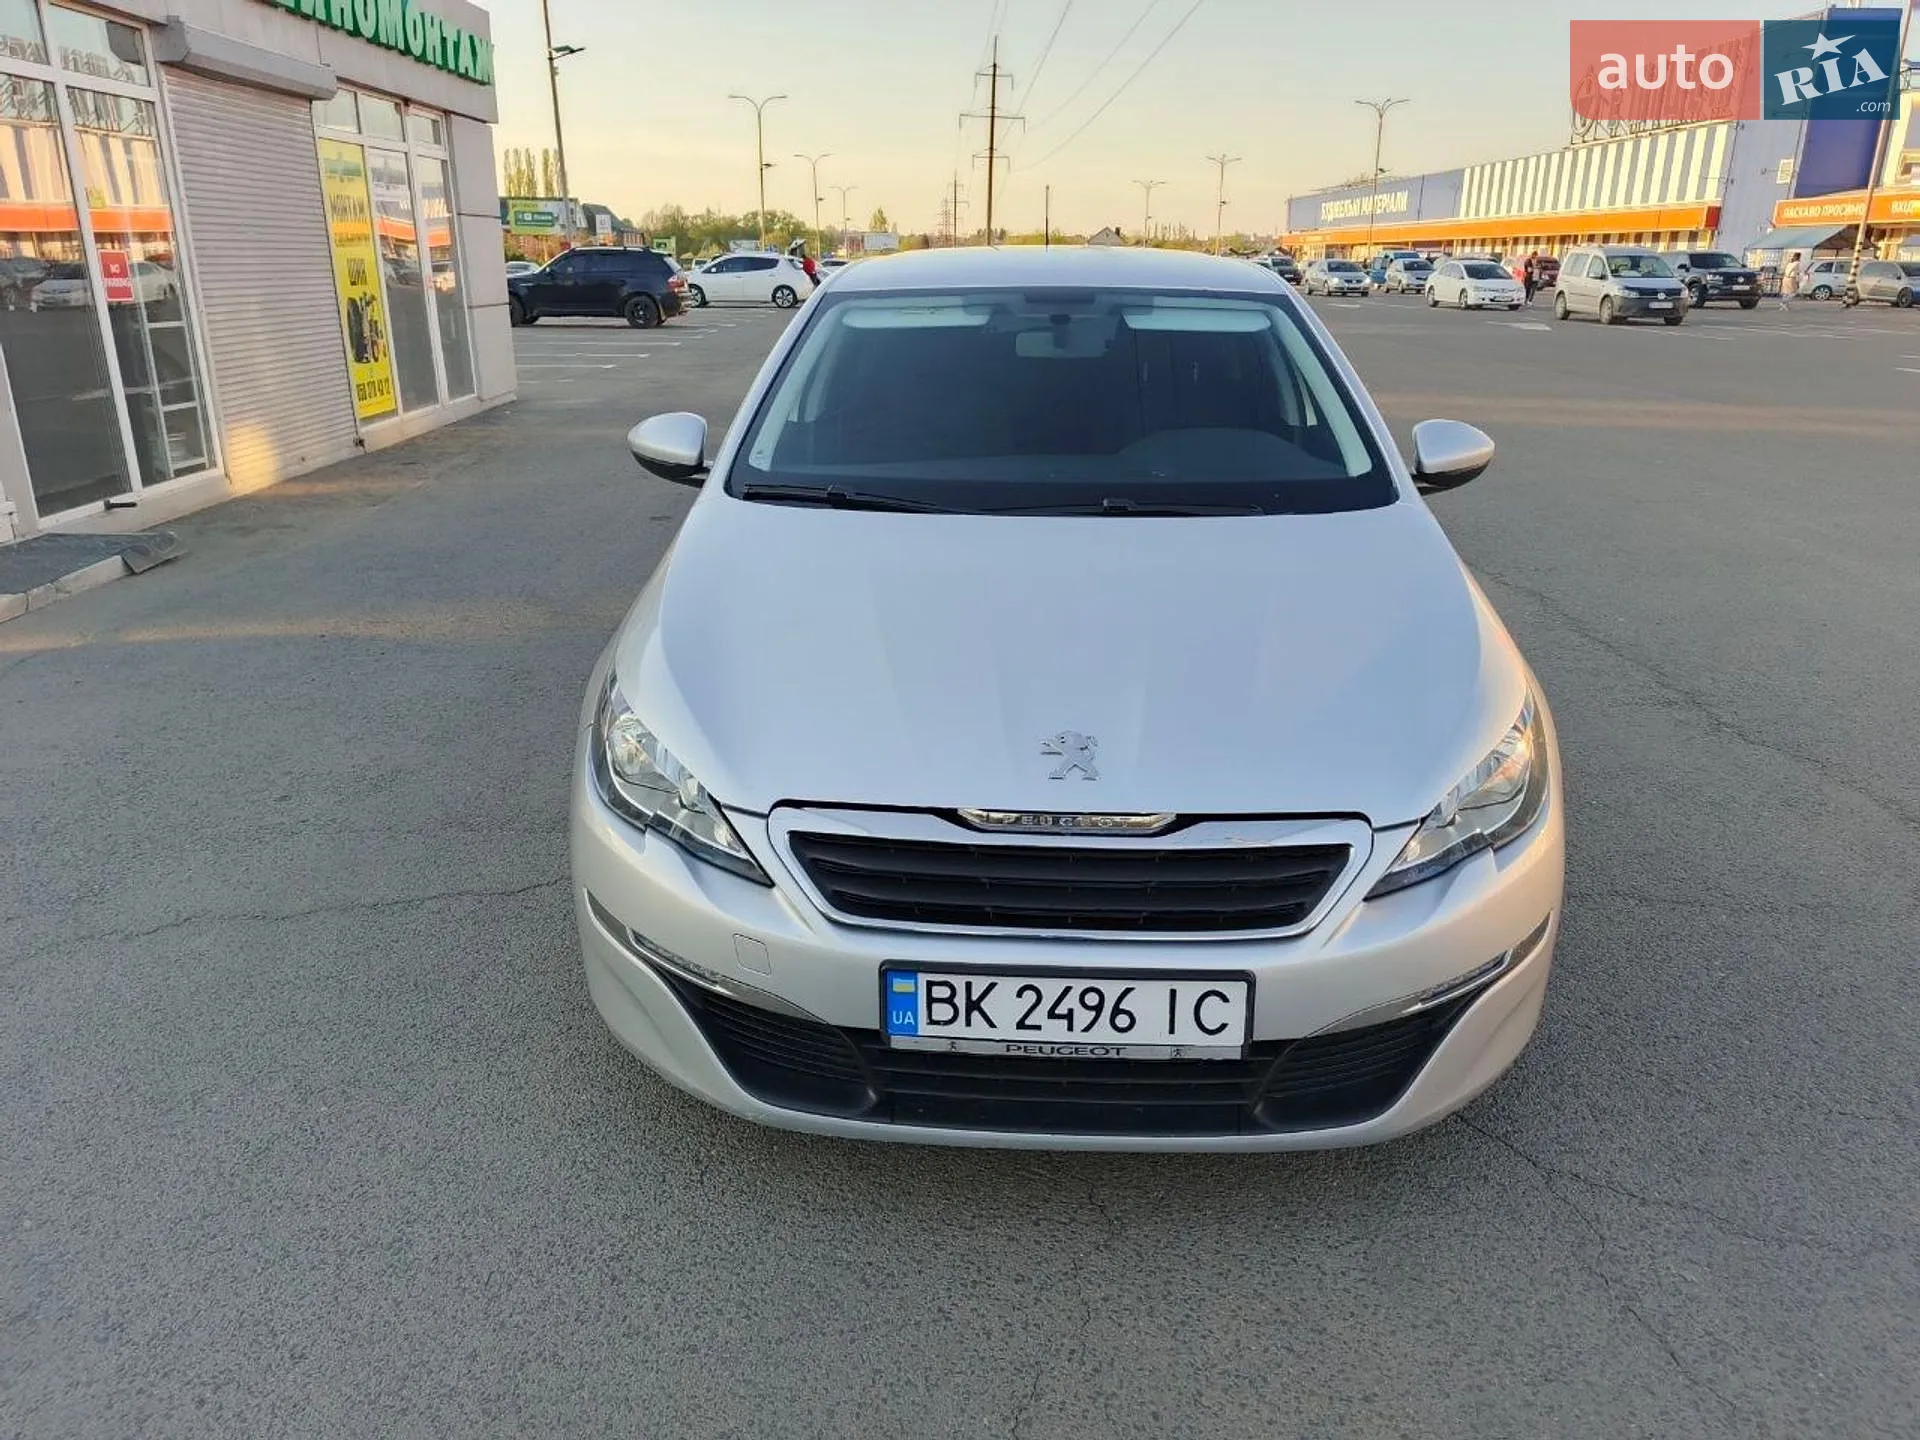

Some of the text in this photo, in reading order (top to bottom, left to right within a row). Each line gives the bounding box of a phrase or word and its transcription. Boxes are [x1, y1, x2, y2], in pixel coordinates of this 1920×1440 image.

[1001, 813, 1129, 828] PEUGEOT
[893, 980, 1232, 1036] UA BK 2496 IC
[1005, 1044, 1131, 1058] PEUGEOT
